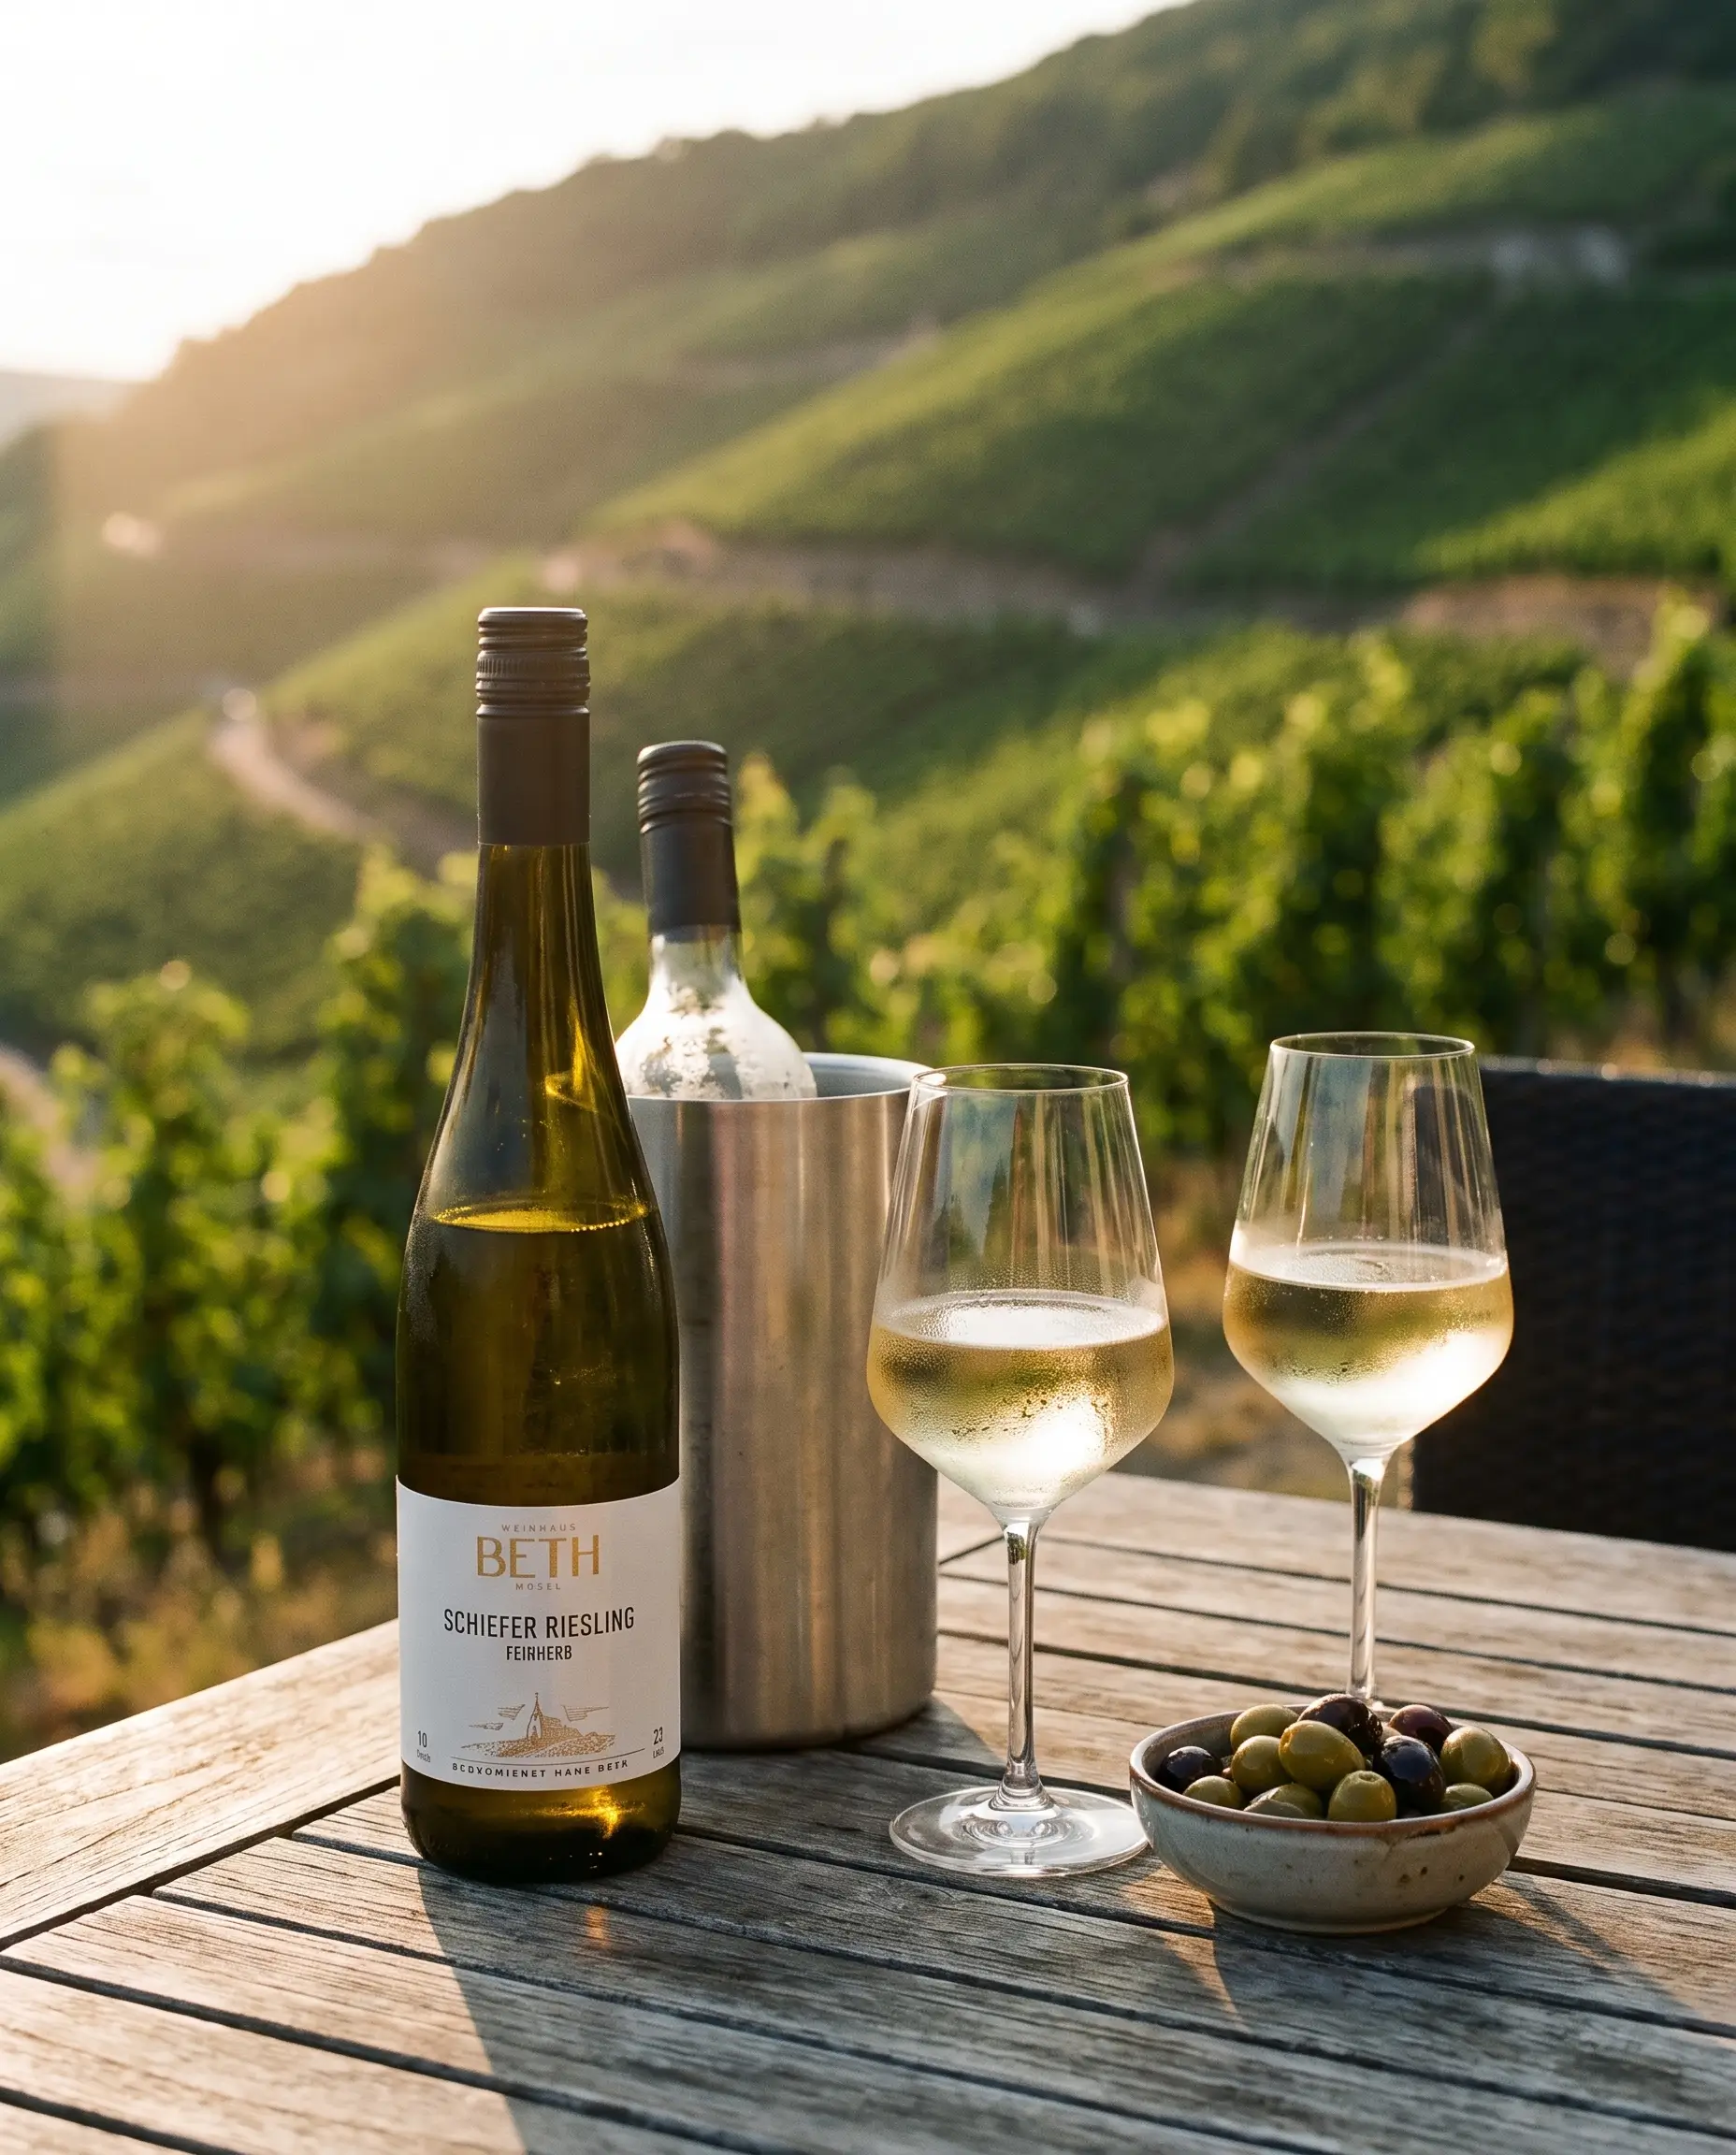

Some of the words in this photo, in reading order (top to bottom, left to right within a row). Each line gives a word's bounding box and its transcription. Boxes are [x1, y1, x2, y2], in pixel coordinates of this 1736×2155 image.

[501, 1523, 576, 1532] WEINHAUS
[477, 1534, 600, 1578] BETH
[515, 1583, 561, 1591] MOSEL
[443, 1608, 537, 1639] SCHIEFER
[546, 1606, 634, 1638] RIESLING
[417, 1730, 427, 1748] 10
[653, 1726, 663, 1745] 23
[555, 1766, 590, 1777] HANE
